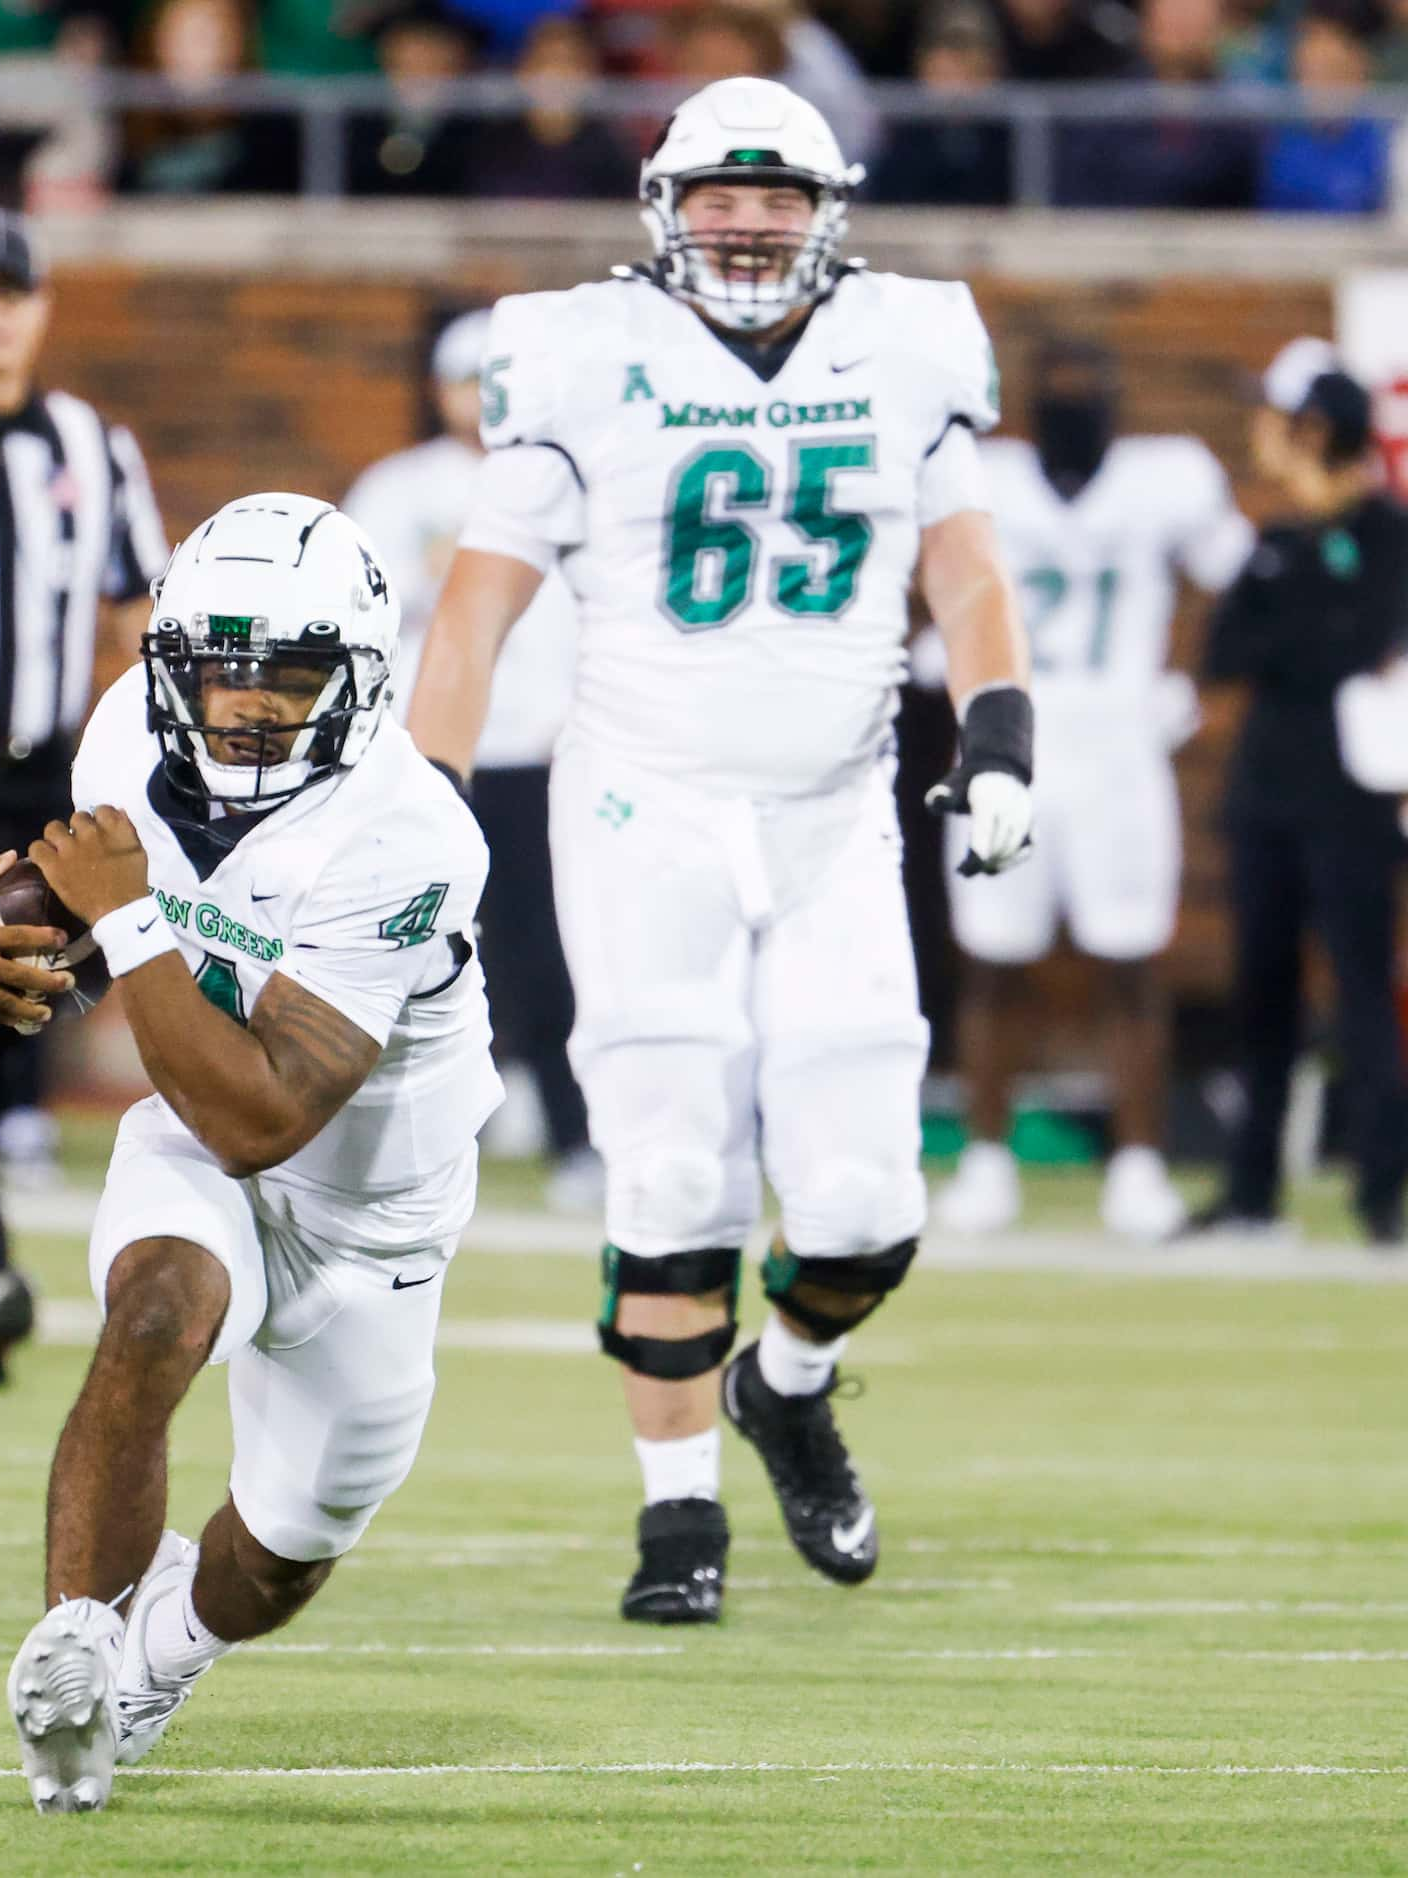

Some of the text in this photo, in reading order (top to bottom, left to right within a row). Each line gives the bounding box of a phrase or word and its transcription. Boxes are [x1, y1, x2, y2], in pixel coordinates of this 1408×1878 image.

[656, 435, 878, 633] 65
[195, 903, 284, 962] GREEN
[379, 882, 451, 951] 4
